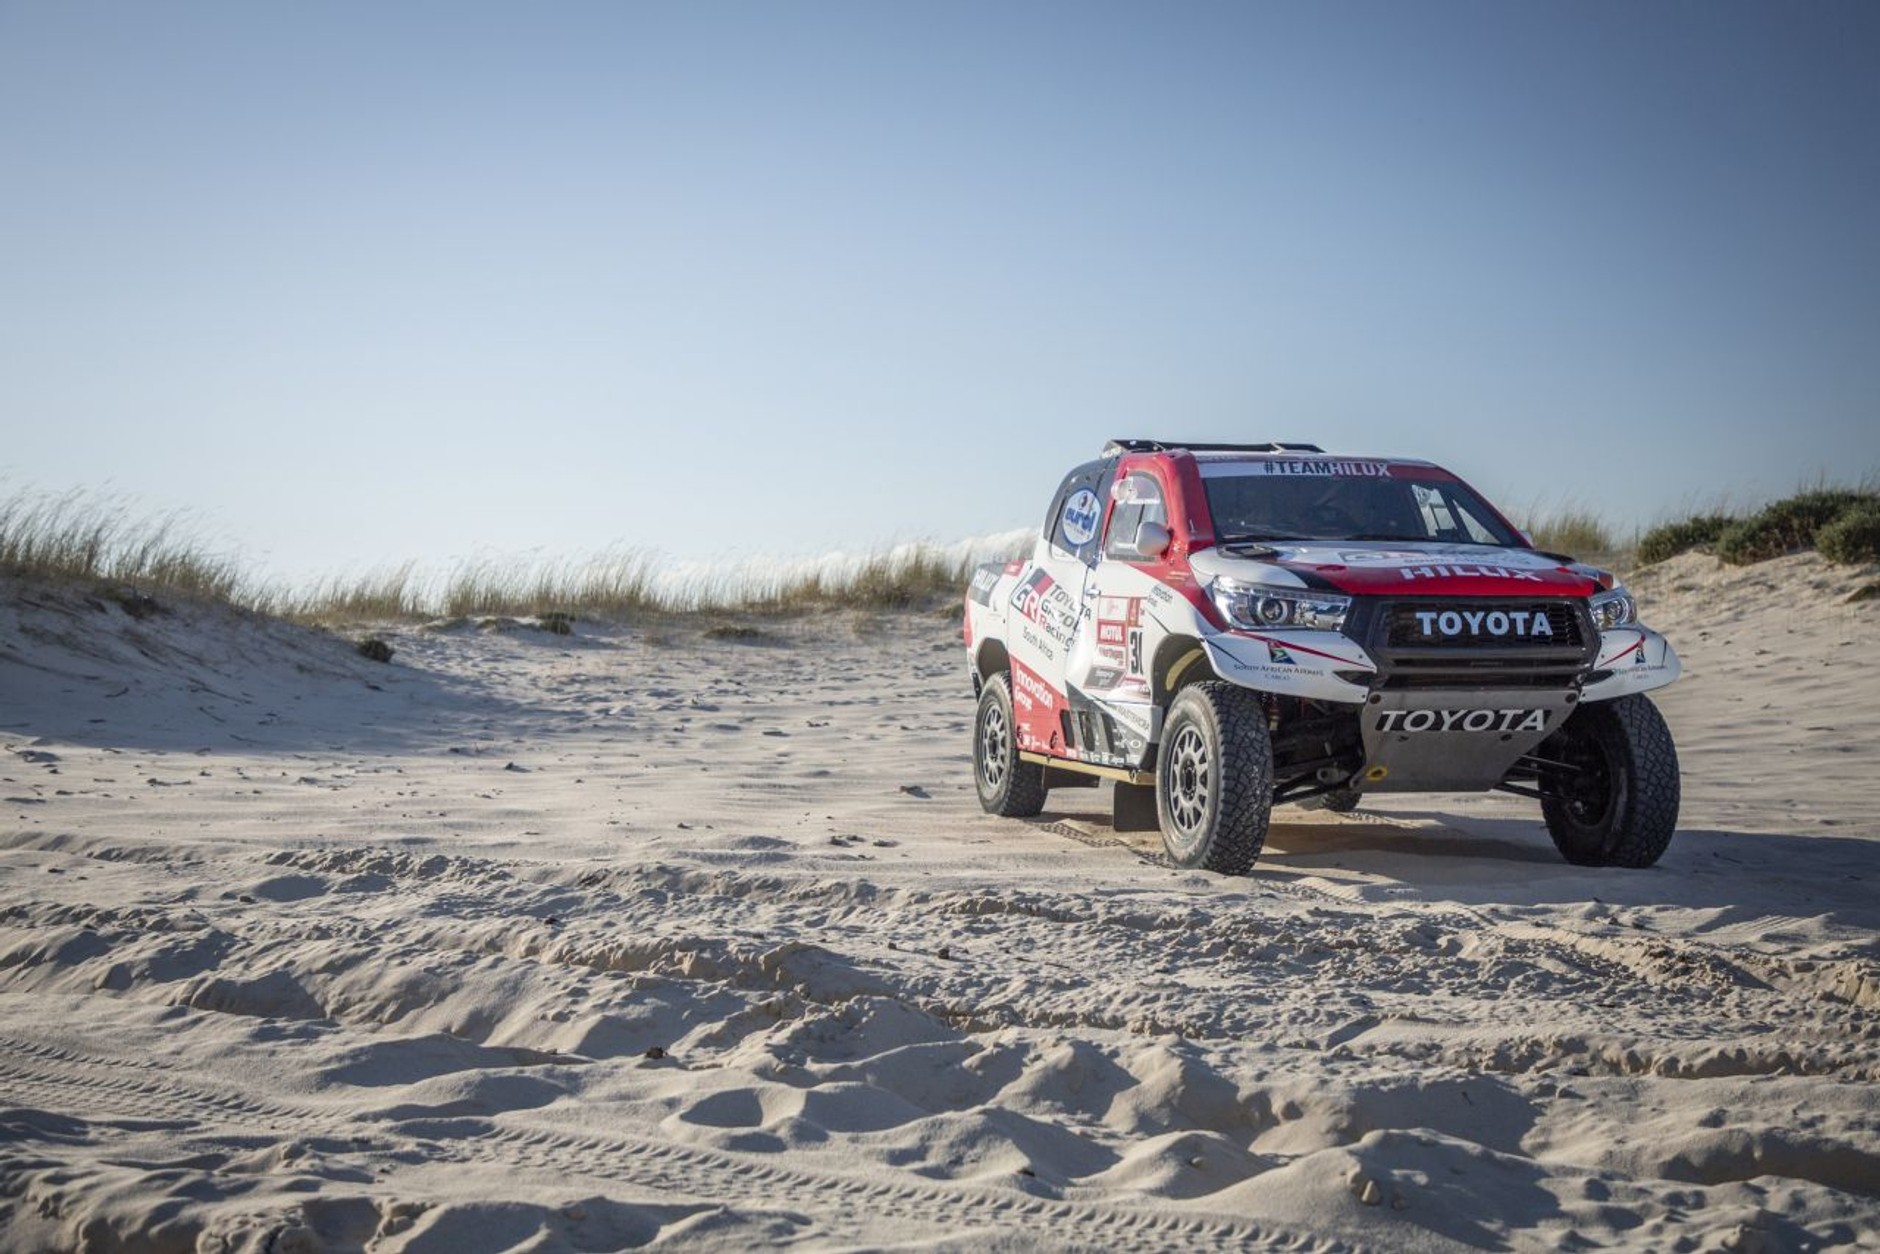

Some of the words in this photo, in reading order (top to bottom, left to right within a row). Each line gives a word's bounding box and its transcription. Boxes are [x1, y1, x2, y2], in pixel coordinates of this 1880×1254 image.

[1264, 460, 1391, 477] #TEAMHILUX
[1401, 564, 1543, 582] HILUX
[1416, 610, 1553, 636] TOYOTA
[1382, 709, 1544, 732] TOYOTA
